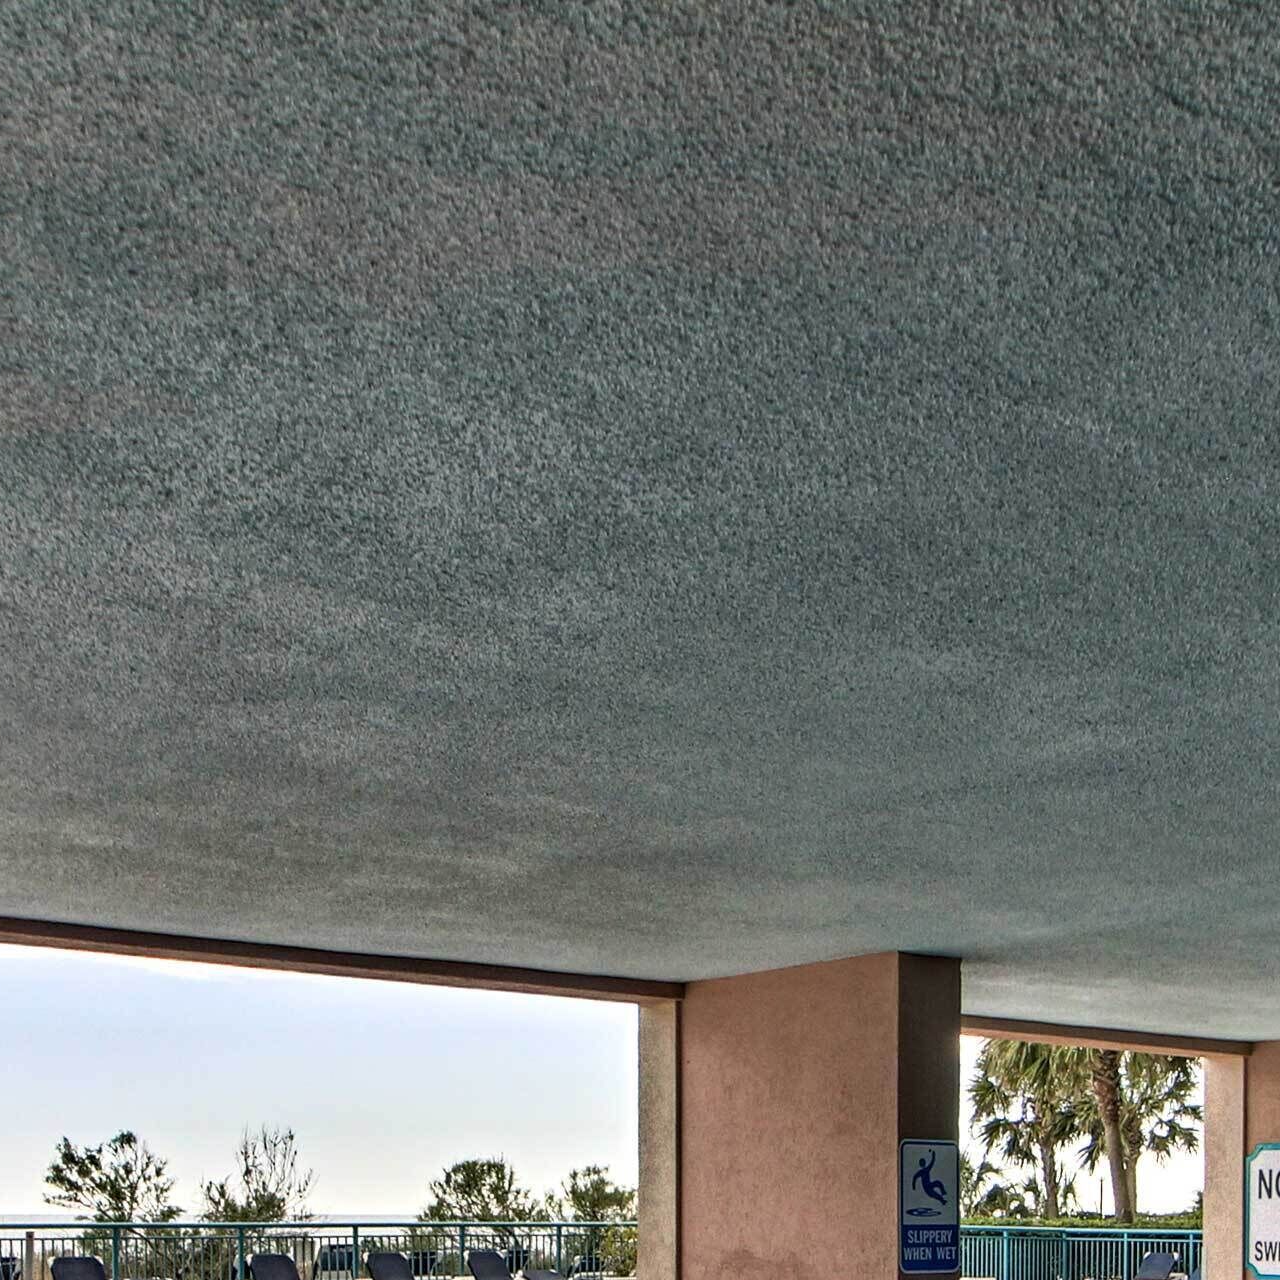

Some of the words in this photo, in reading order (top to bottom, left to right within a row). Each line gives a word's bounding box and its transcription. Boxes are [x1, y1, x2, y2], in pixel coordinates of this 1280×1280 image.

[907, 1230, 953, 1244] SLIPPERY
[903, 1247, 932, 1261] WHEN
[936, 1246, 957, 1260] WET
